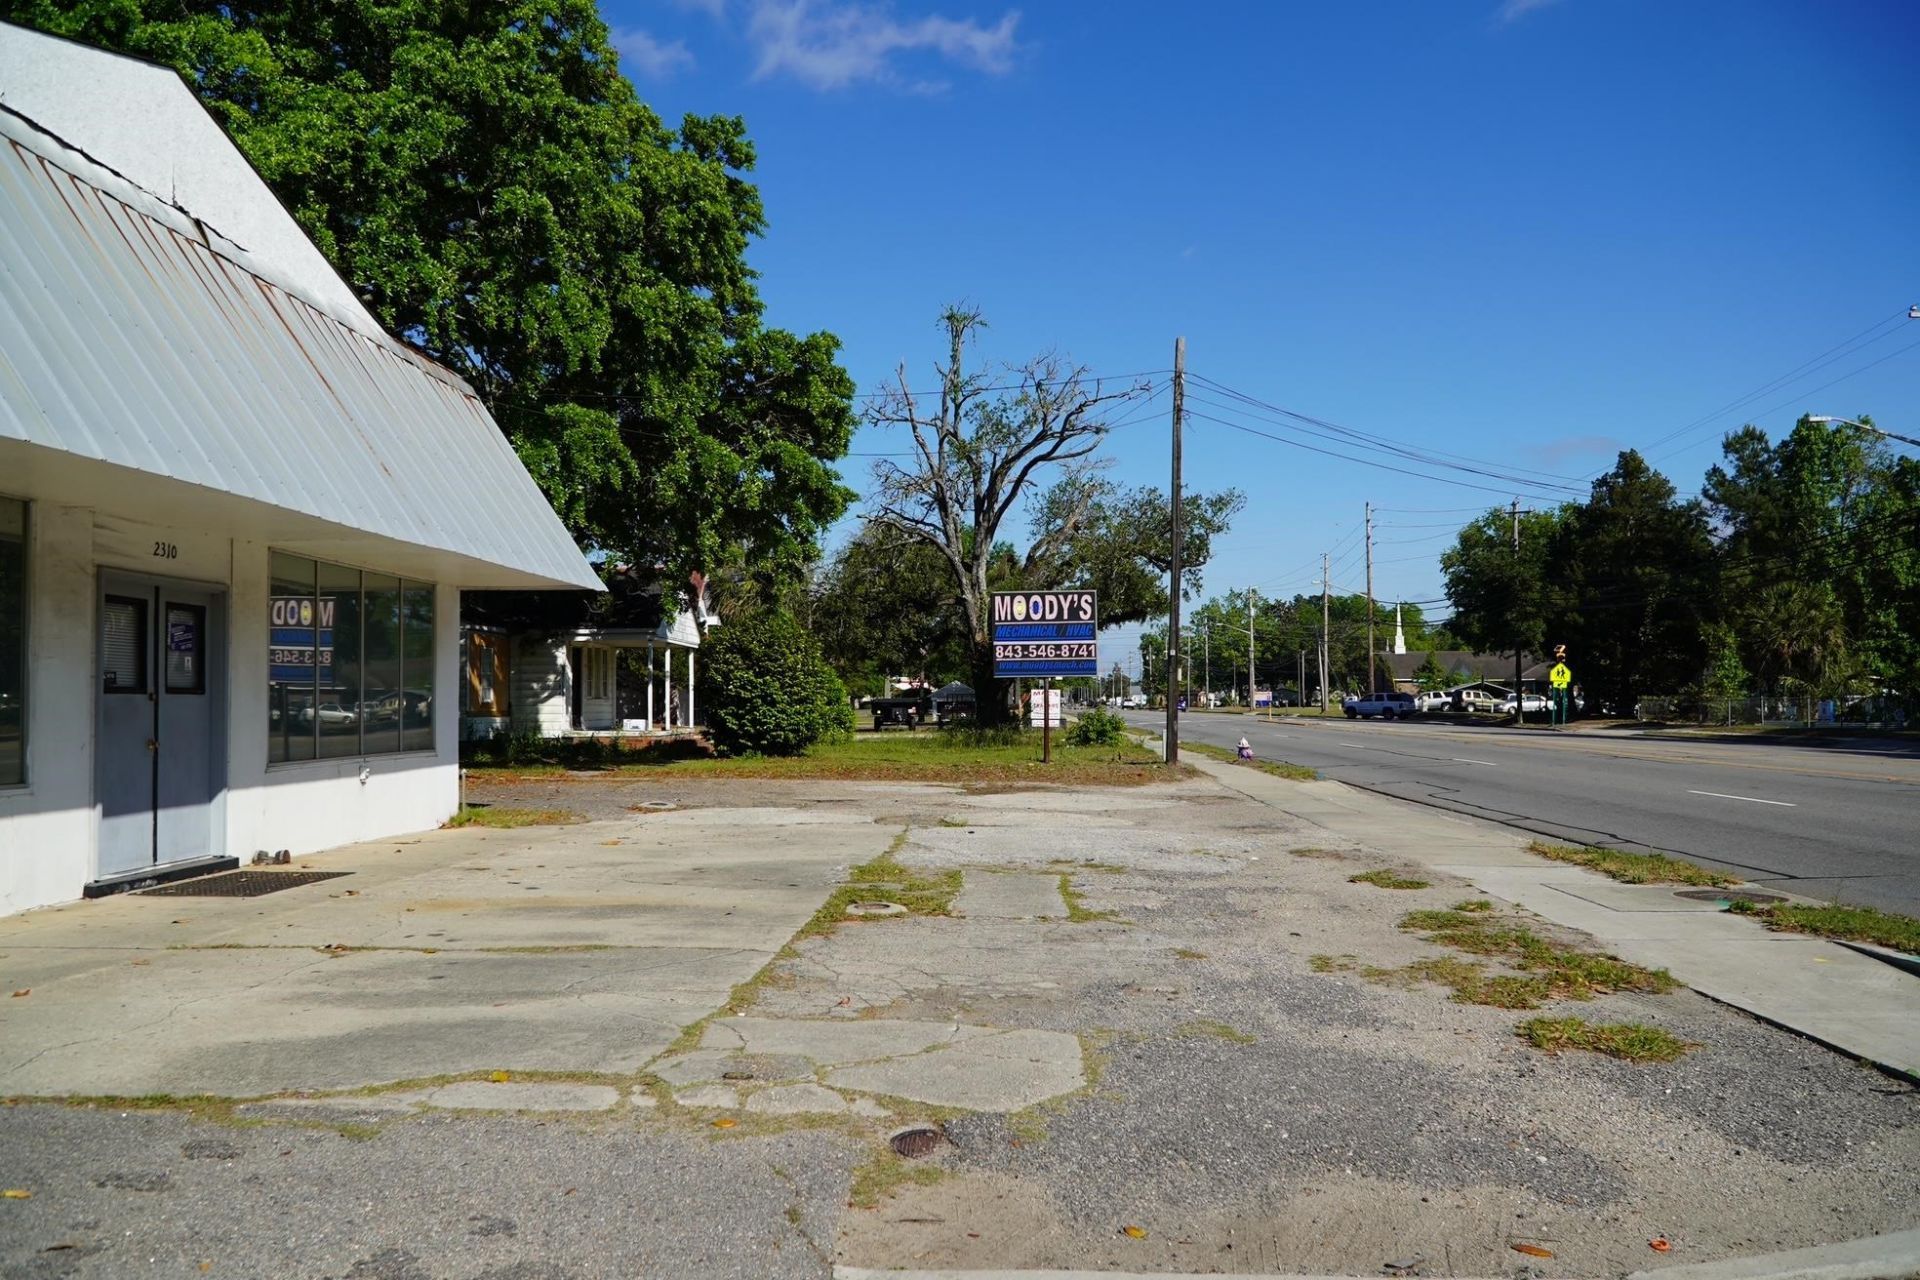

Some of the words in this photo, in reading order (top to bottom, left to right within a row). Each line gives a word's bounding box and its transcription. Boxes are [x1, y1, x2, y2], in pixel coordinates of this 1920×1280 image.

[153, 541, 177, 559] 2310
[994, 594, 1093, 621] MOODY'S
[995, 625, 1058, 637] MECHANICAL
[1065, 624, 1093, 637] HVAC
[995, 644, 1096, 658] 843-546-8741
